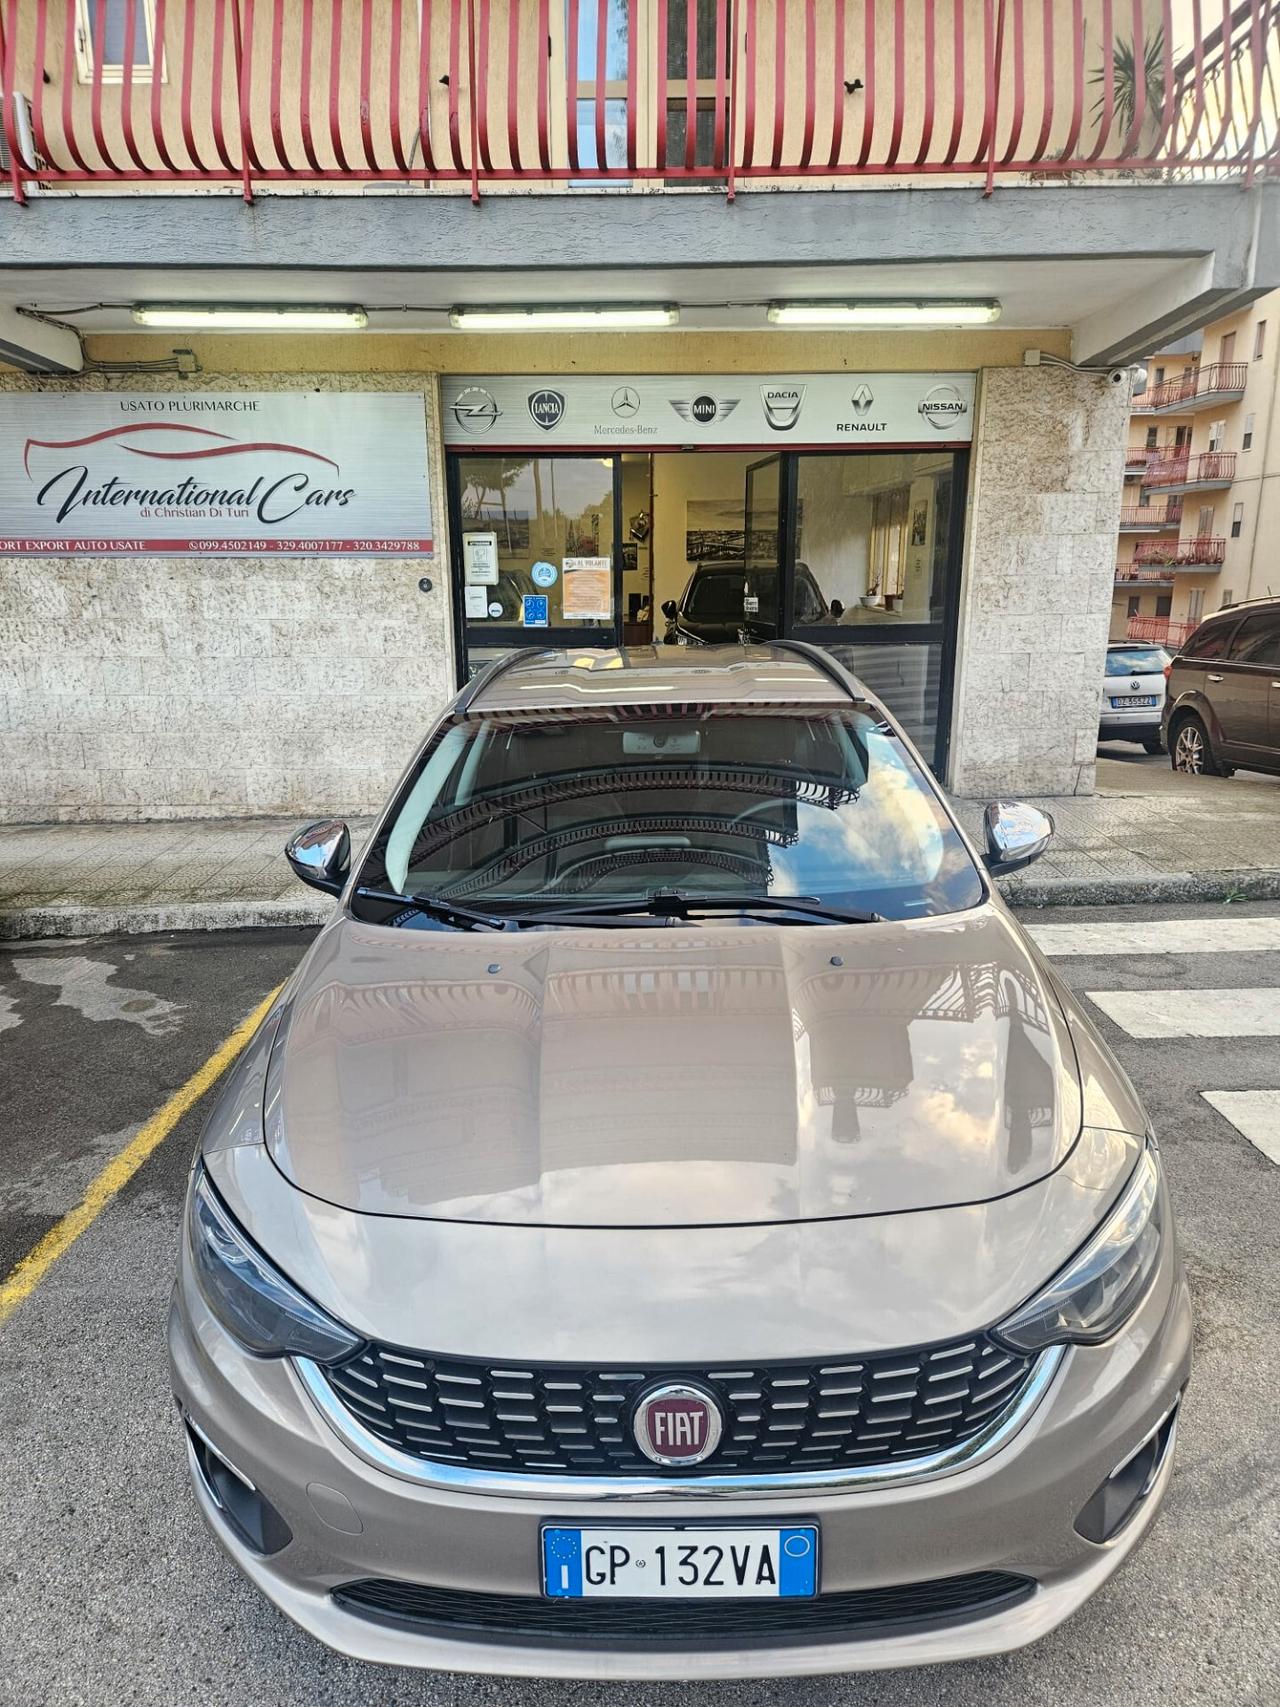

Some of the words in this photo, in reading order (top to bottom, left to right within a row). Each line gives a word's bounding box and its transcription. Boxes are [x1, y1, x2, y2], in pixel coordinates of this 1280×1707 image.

[766, 391, 799, 399] DACIA
[120, 400, 165, 412] USATO
[168, 400, 261, 412] PLURIMARCHE
[534, 402, 560, 414] LANCIA
[693, 403, 716, 416] MINI
[922, 402, 964, 412] NISSAN
[593, 424, 659, 436] Mercedes-Benz
[836, 423, 888, 432] RENAULT
[37, 465, 265, 524] International
[257, 473, 357, 524] Cars
[140, 507, 152, 518] di
[154, 507, 206, 518] Christian
[209, 507, 223, 518] Di
[225, 507, 250, 518] Turi
[0, 541, 22, 550] ORT
[25, 541, 71, 550] EXPORT
[74, 541, 107, 550] AUTO
[110, 541, 146, 550] USATE
[200, 541, 267, 550] 099.4502149
[276, 541, 344, 550] 329.4007177
[352, 540, 420, 550] 320.3429788
[654, 1411, 704, 1446] FIAT
[585, 1545, 631, 1586] GP
[654, 1545, 777, 1586] 132VA
